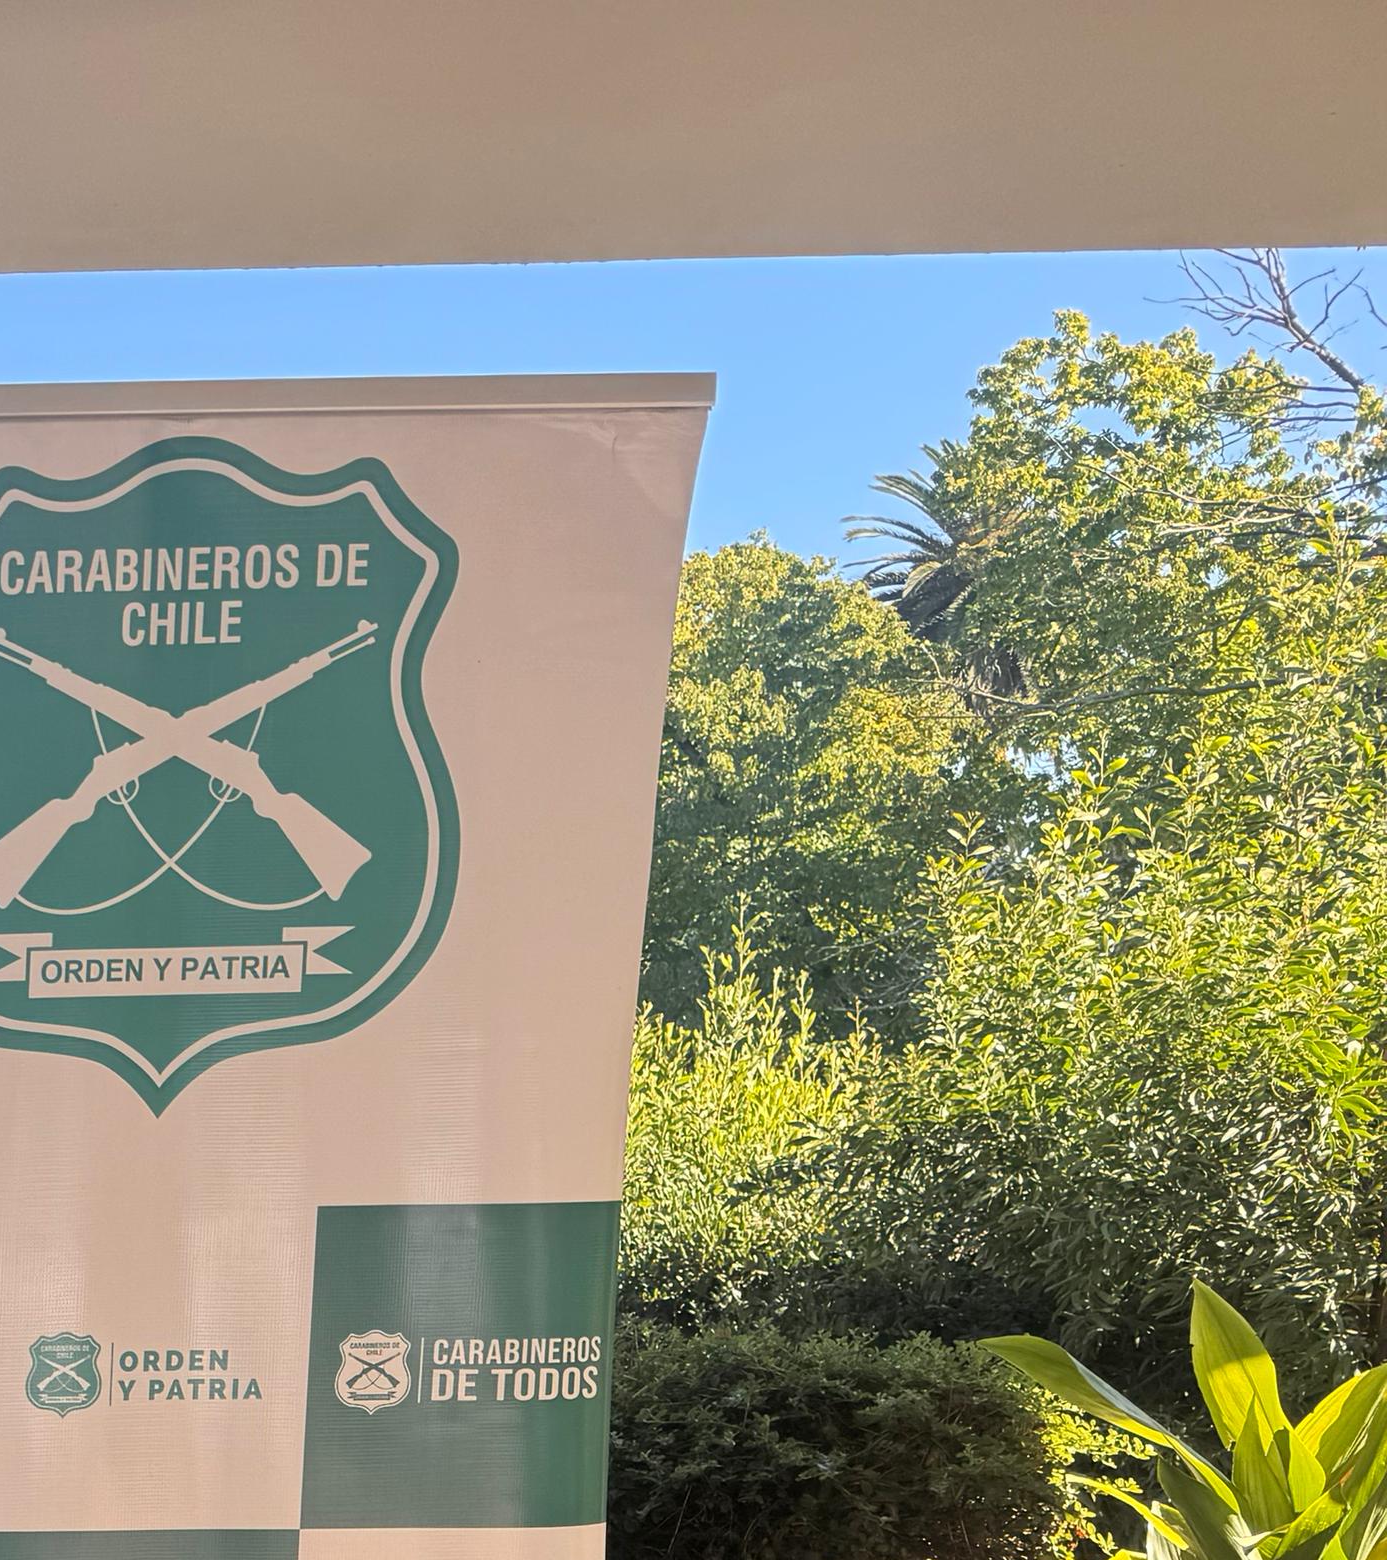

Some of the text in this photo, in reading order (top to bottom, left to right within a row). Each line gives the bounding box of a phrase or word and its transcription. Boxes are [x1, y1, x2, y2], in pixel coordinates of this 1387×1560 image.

[0, 543, 370, 596] CARABINEROS DE
[121, 601, 243, 647] CHILE
[40, 955, 291, 985] ORDEN Y PATRIA
[119, 1349, 229, 1372] ORDEN
[433, 1336, 601, 1364] CARABINEROS
[118, 1378, 263, 1400] Y PATRIA
[431, 1365, 599, 1402] DE TODOS
